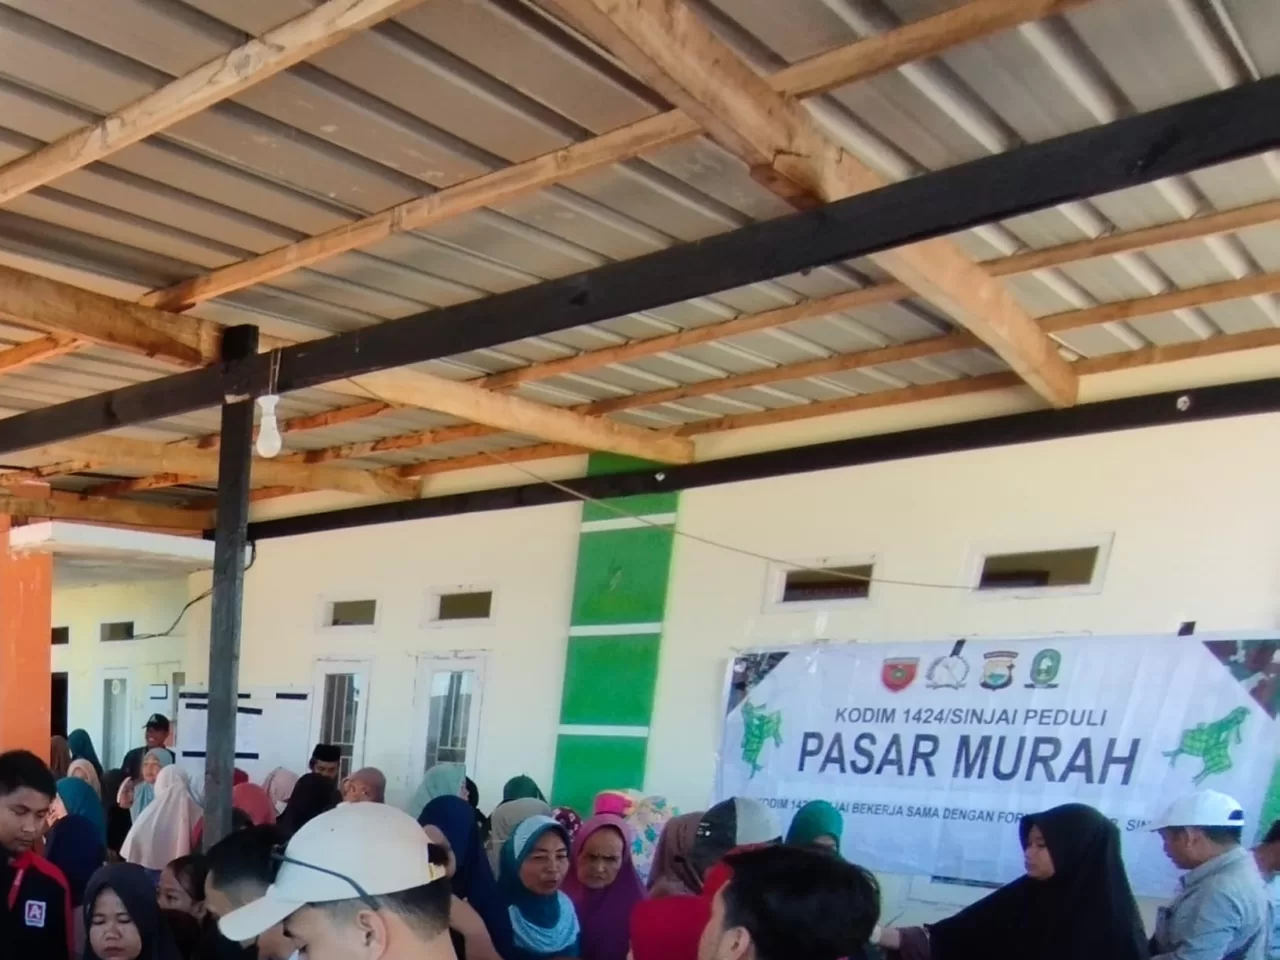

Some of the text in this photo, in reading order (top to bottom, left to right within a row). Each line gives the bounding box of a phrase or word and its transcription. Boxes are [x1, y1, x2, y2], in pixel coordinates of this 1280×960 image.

[835, 707, 1108, 727] KODIM 1424/SINJAI PEDULI
[798, 731, 1141, 786] PASAR MURAH
[851, 803, 904, 817] BEKERJA
[906, 805, 940, 820] SAMA
[942, 807, 995, 823] DENGAN
